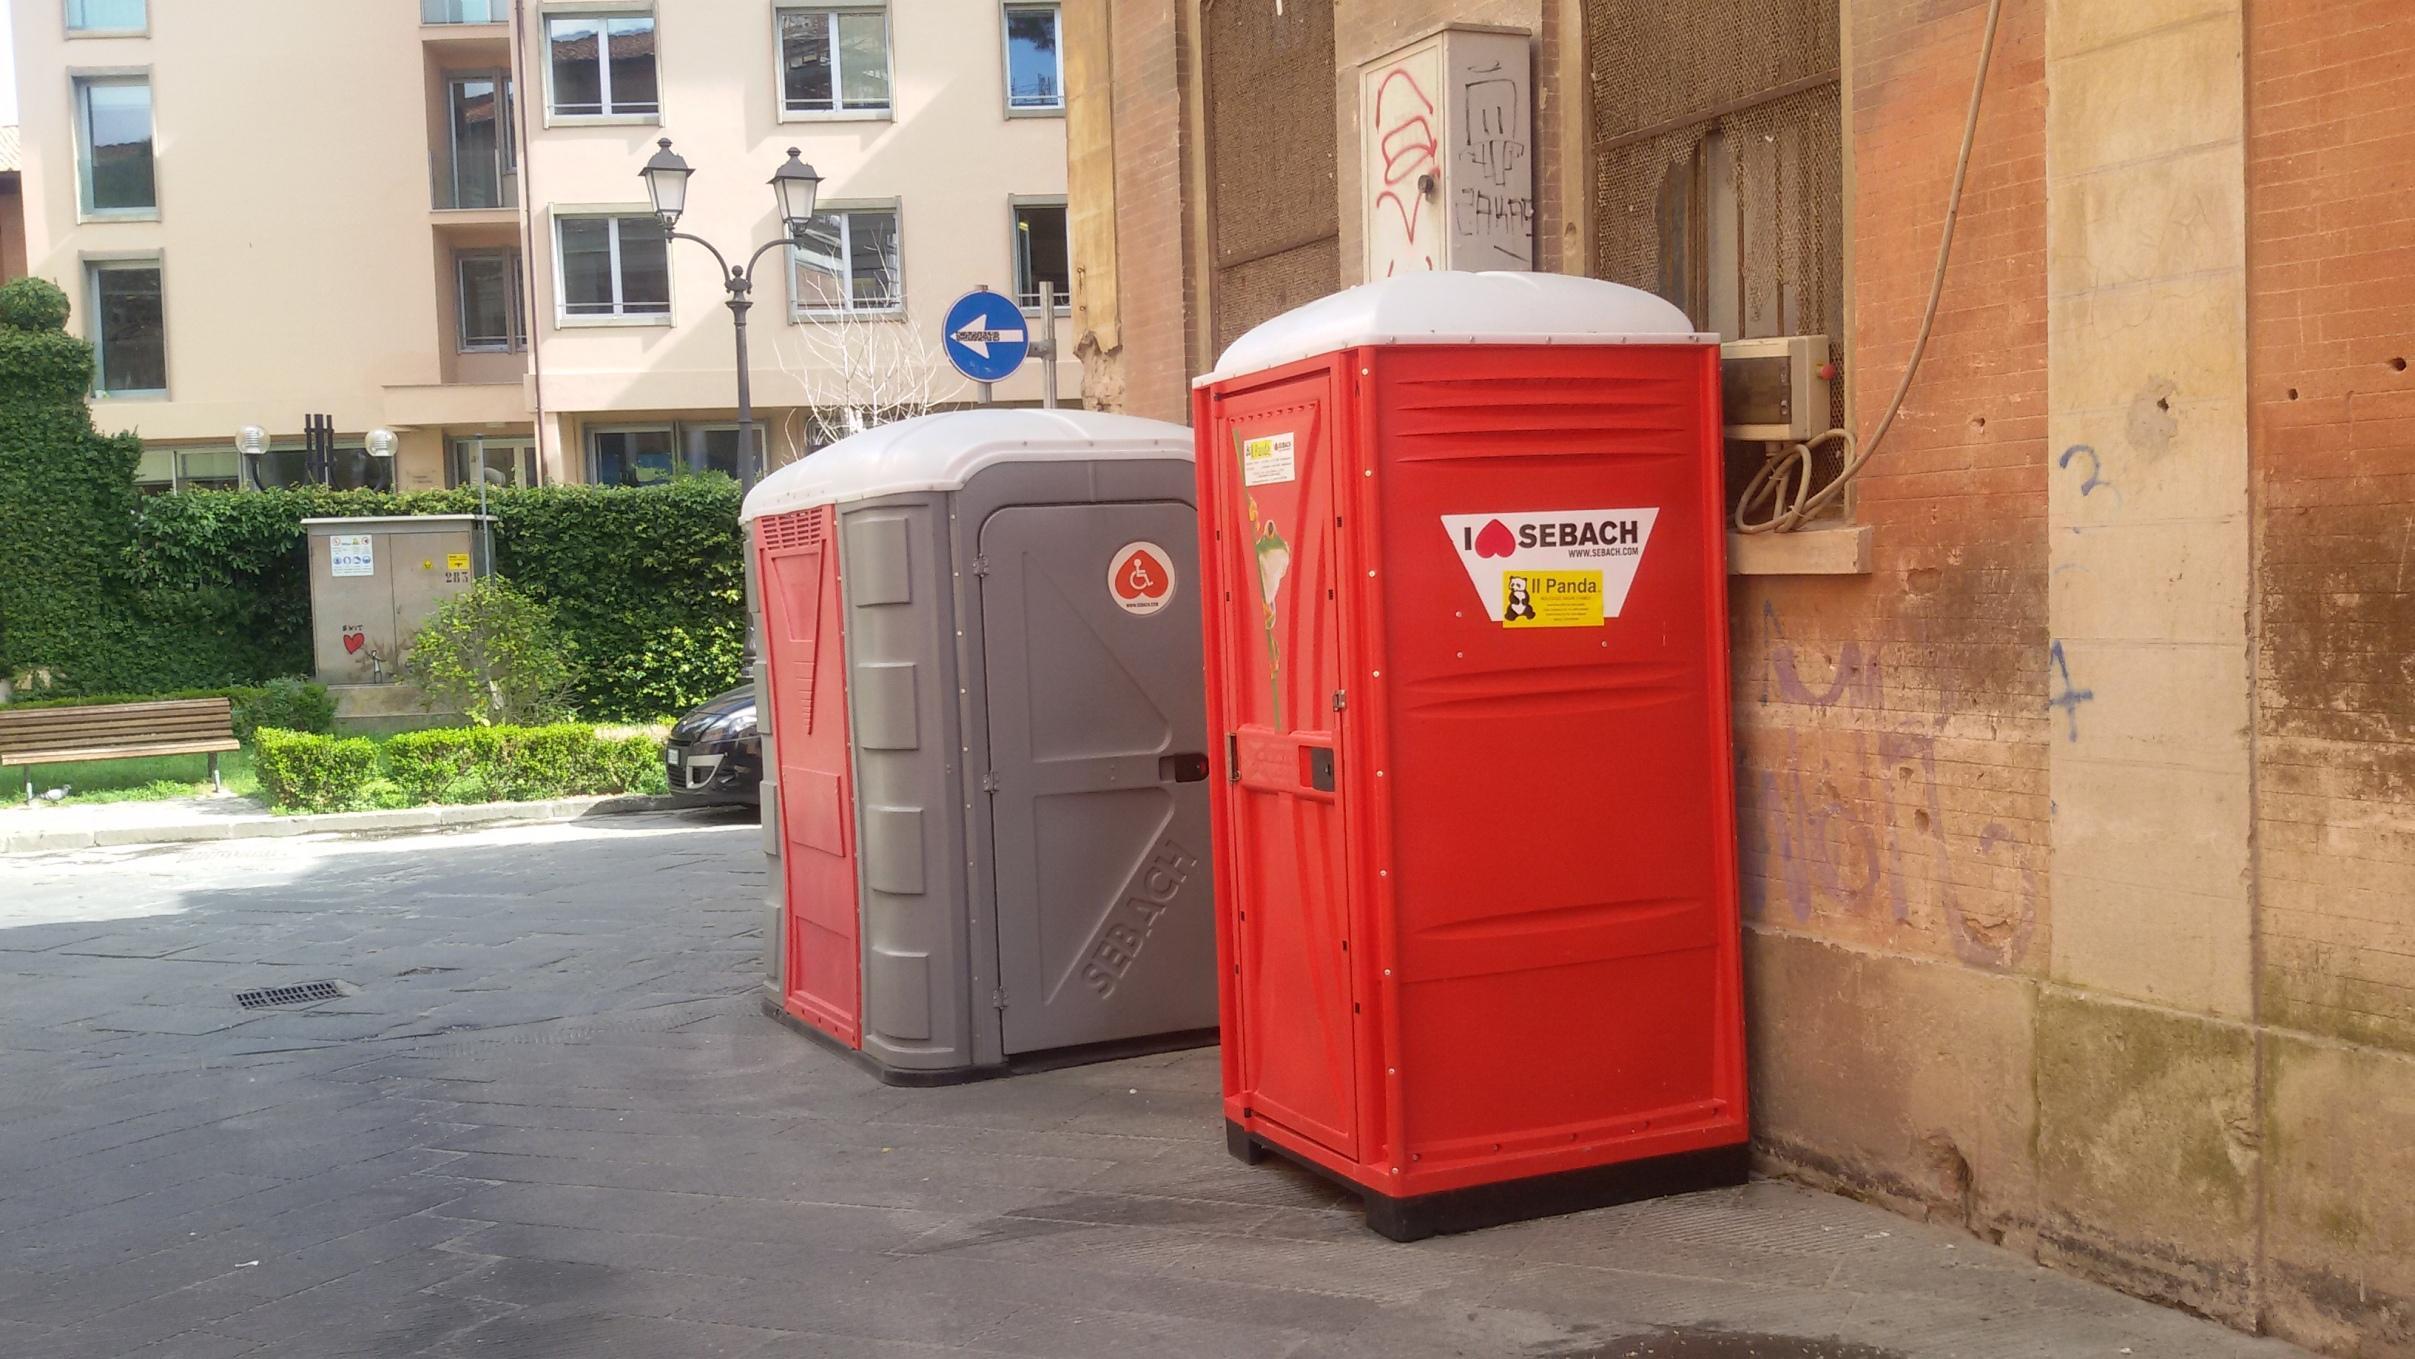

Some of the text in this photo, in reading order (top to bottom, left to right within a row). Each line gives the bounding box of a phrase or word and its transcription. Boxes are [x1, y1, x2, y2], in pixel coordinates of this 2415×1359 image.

[1464, 521, 1638, 550] I SEBACH
[1568, 547, 1639, 558] WWW.SEBACH.COM
[1546, 577, 1597, 594] Panda
[1082, 840, 1198, 1000] SEBACH
